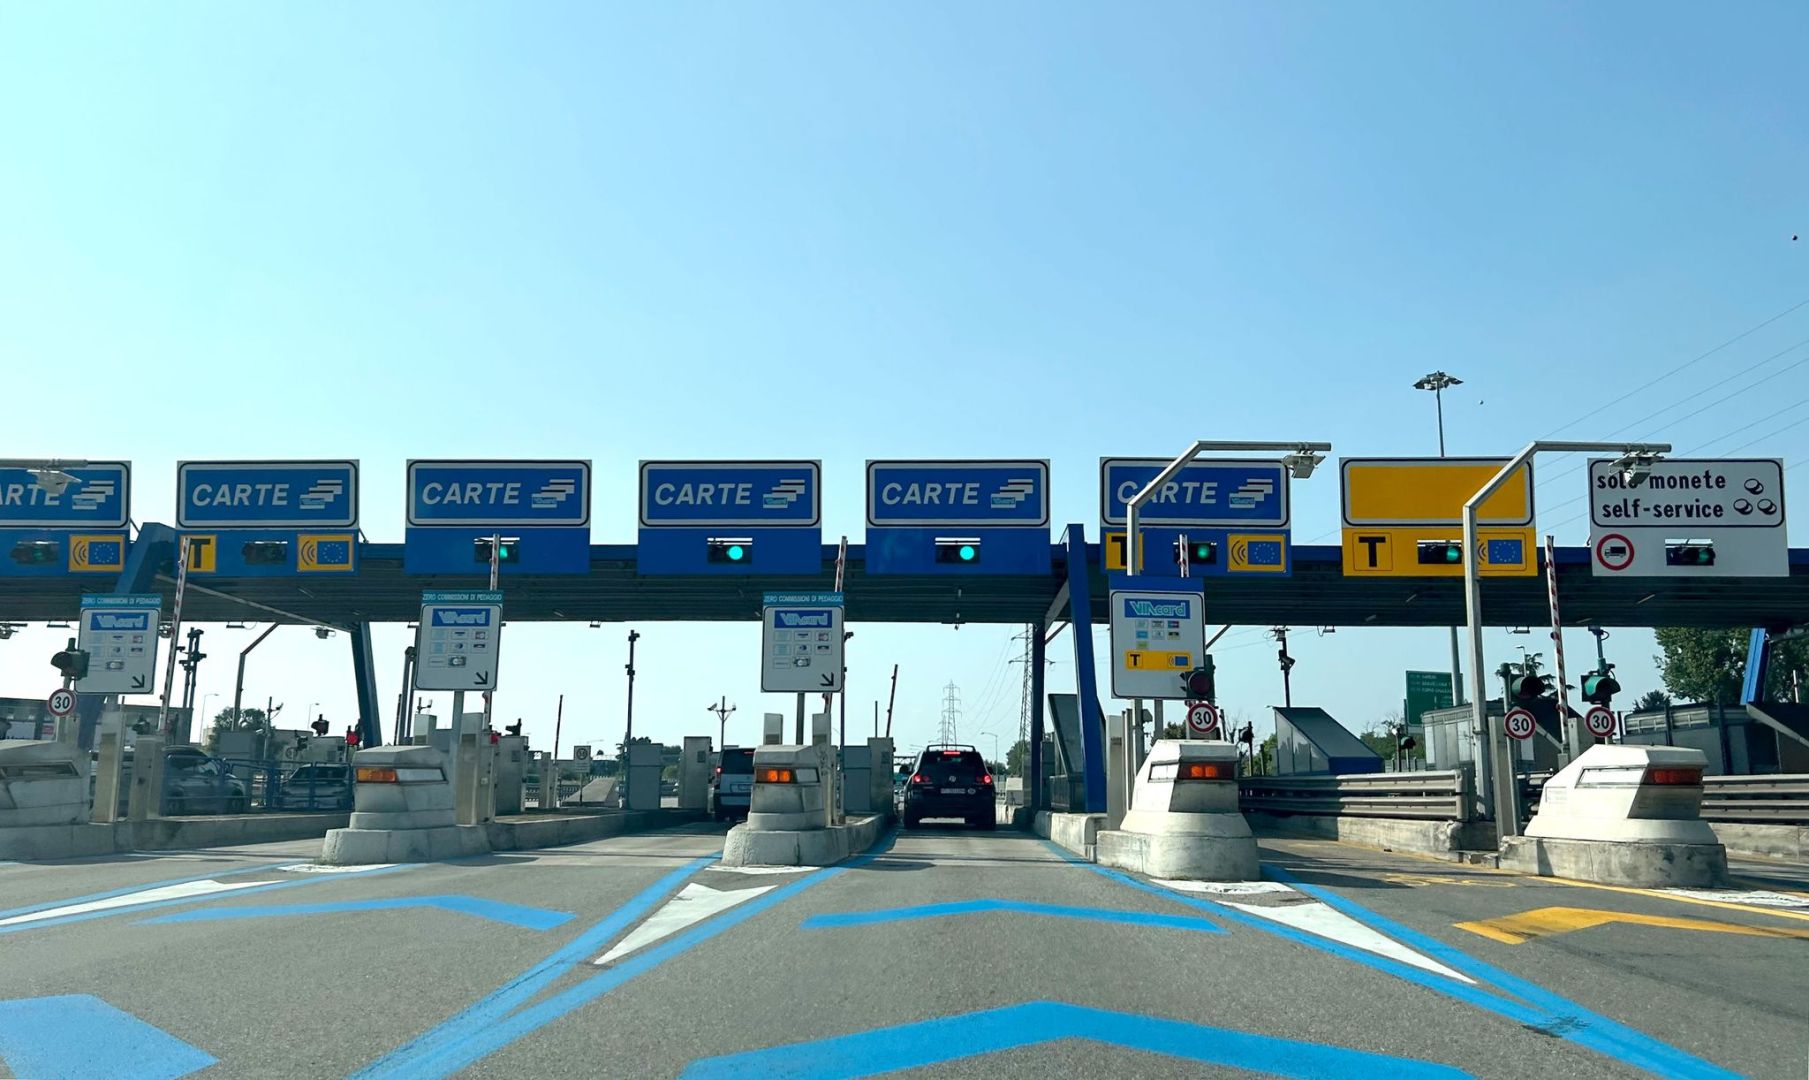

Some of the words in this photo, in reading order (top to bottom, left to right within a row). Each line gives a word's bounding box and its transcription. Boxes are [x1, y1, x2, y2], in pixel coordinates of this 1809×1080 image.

[1649, 470, 1726, 489] monete
[192, 484, 288, 505] CARTE
[423, 483, 520, 504] CARTE
[654, 483, 752, 504] CARTE
[883, 483, 979, 504] CARTE
[1602, 498, 1724, 518] self-service
[190, 538, 211, 568] T
[1359, 536, 1386, 567] T
[1130, 654, 1140, 666] T
[54, 696, 70, 709] 30
[1195, 711, 1211, 726] 30
[1512, 718, 1530, 732] 30
[1592, 715, 1609, 729] 30
